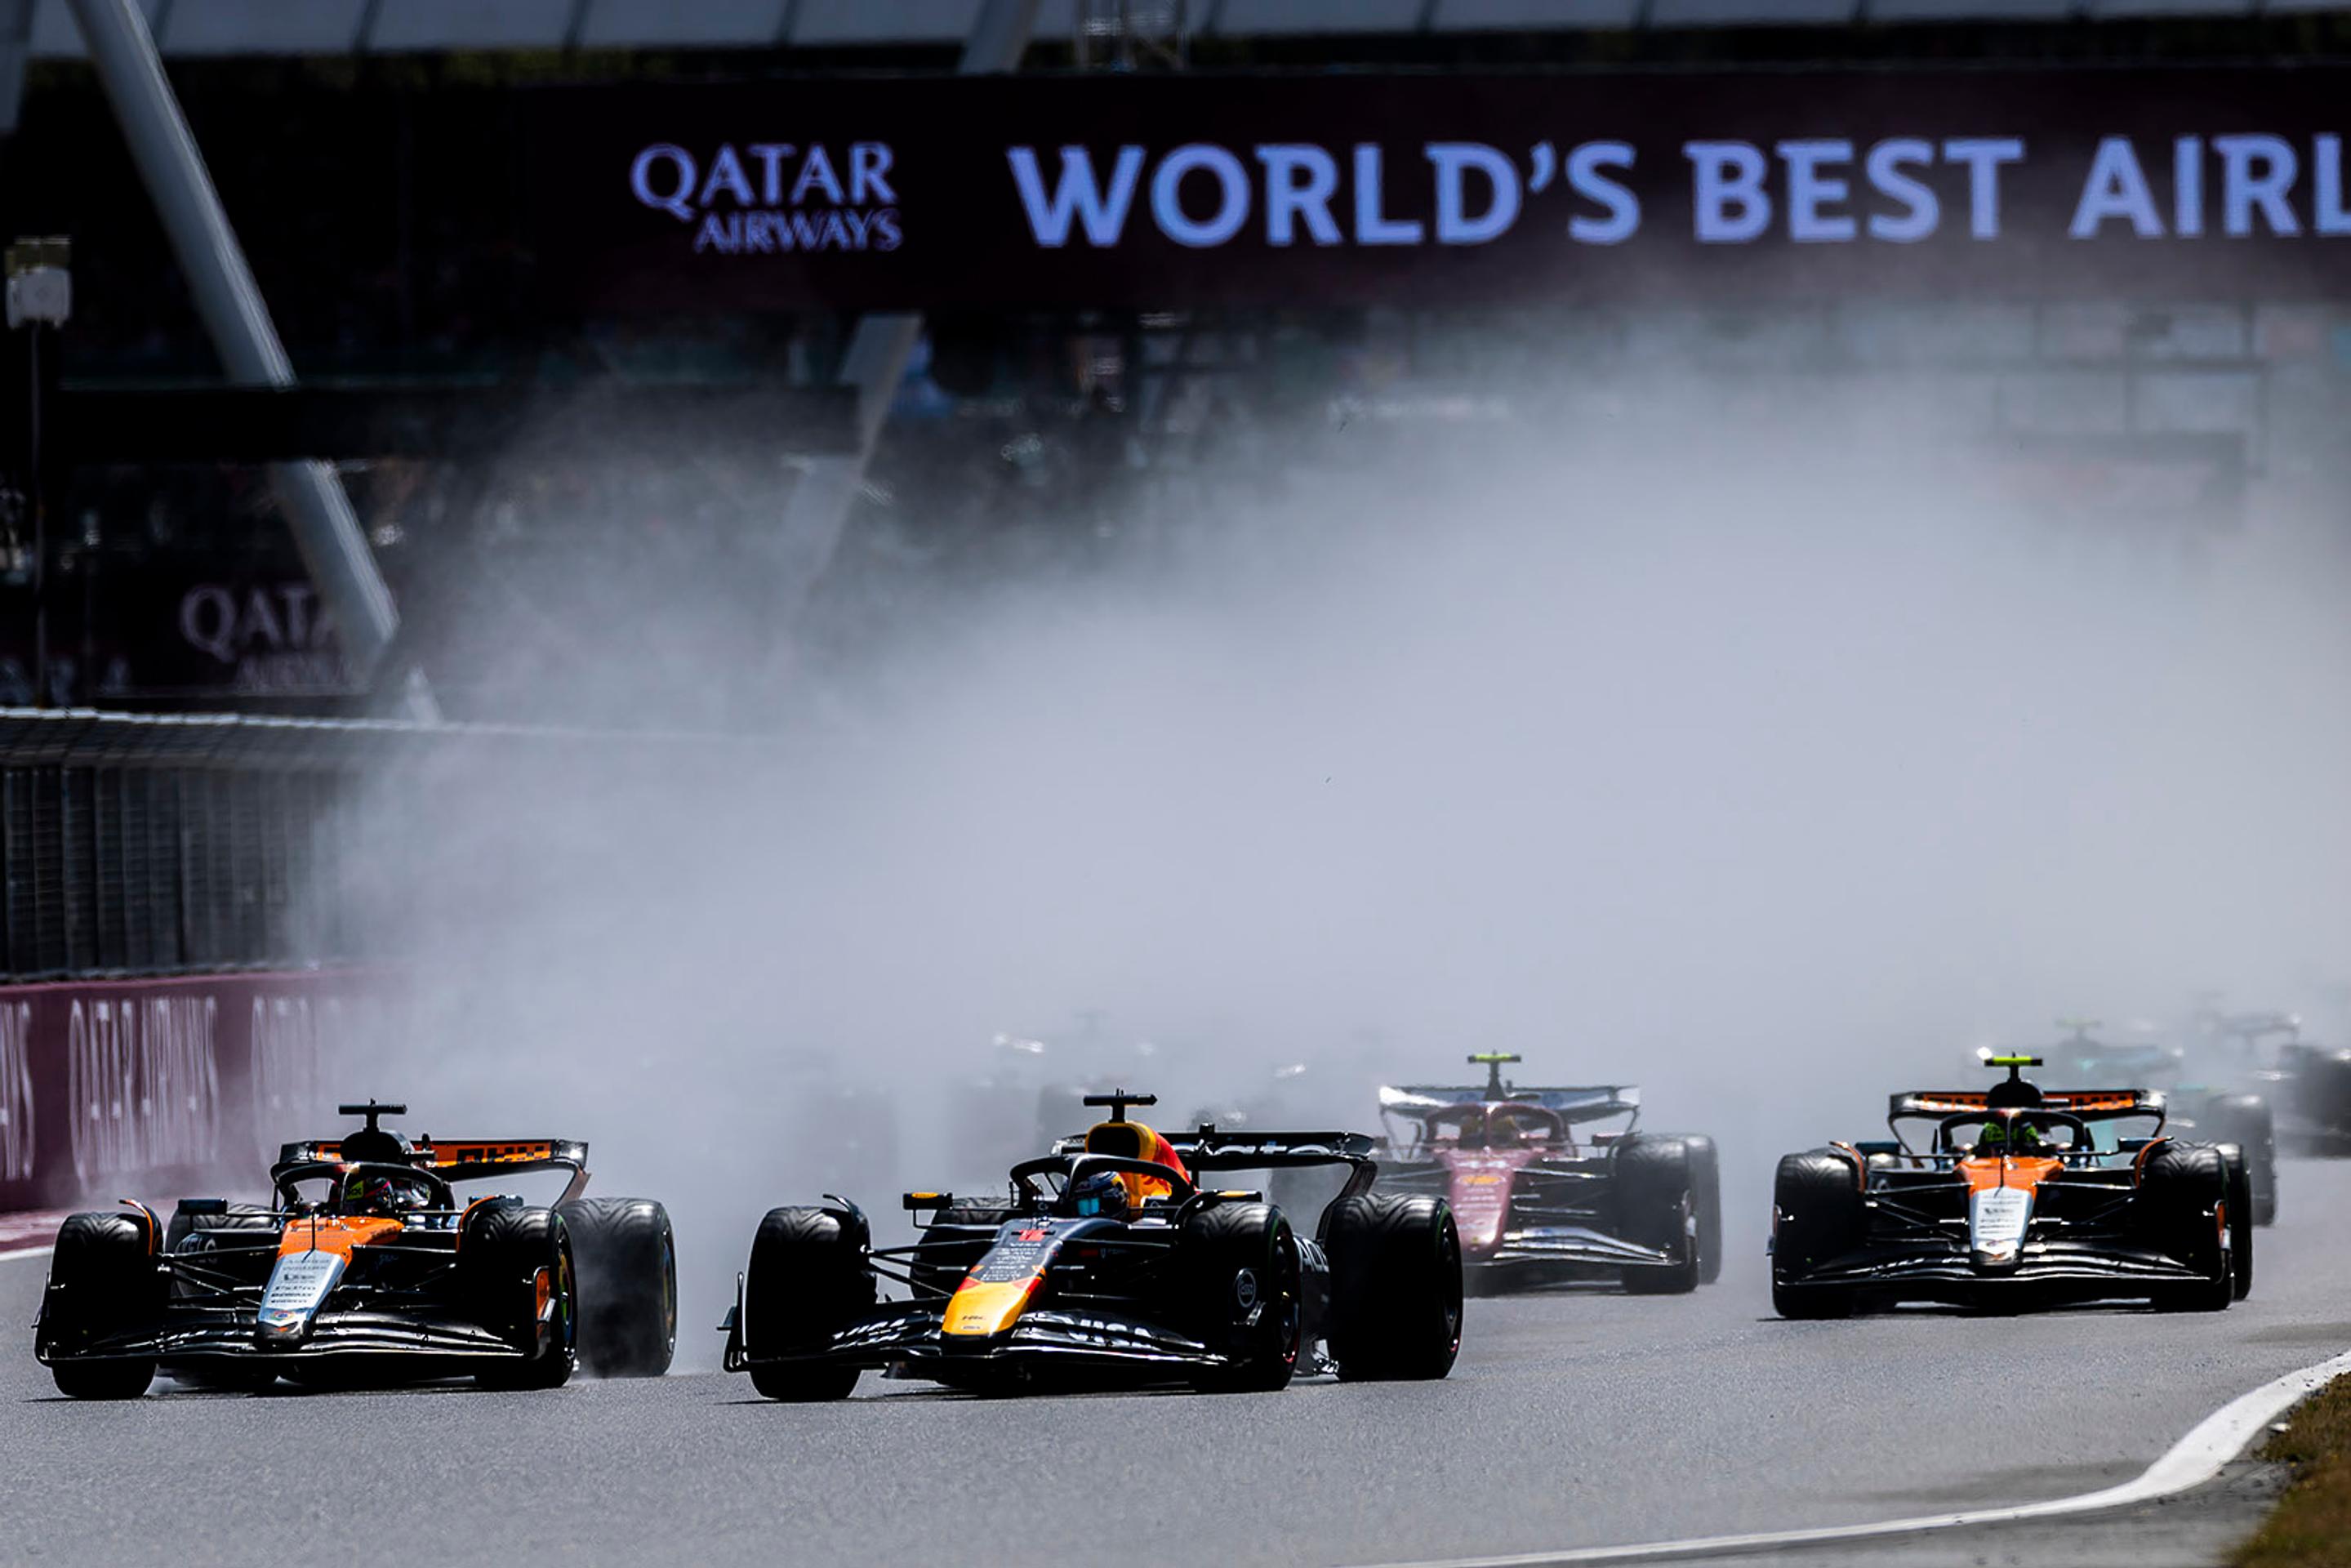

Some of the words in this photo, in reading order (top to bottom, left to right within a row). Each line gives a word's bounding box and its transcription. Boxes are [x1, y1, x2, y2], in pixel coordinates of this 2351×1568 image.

[630, 142, 897, 221] QATAR
[1008, 142, 1641, 247] WORLD'S
[1684, 139, 2023, 242] BEST
[695, 209, 902, 253] AIRWAYS
[181, 586, 336, 662] QAT
